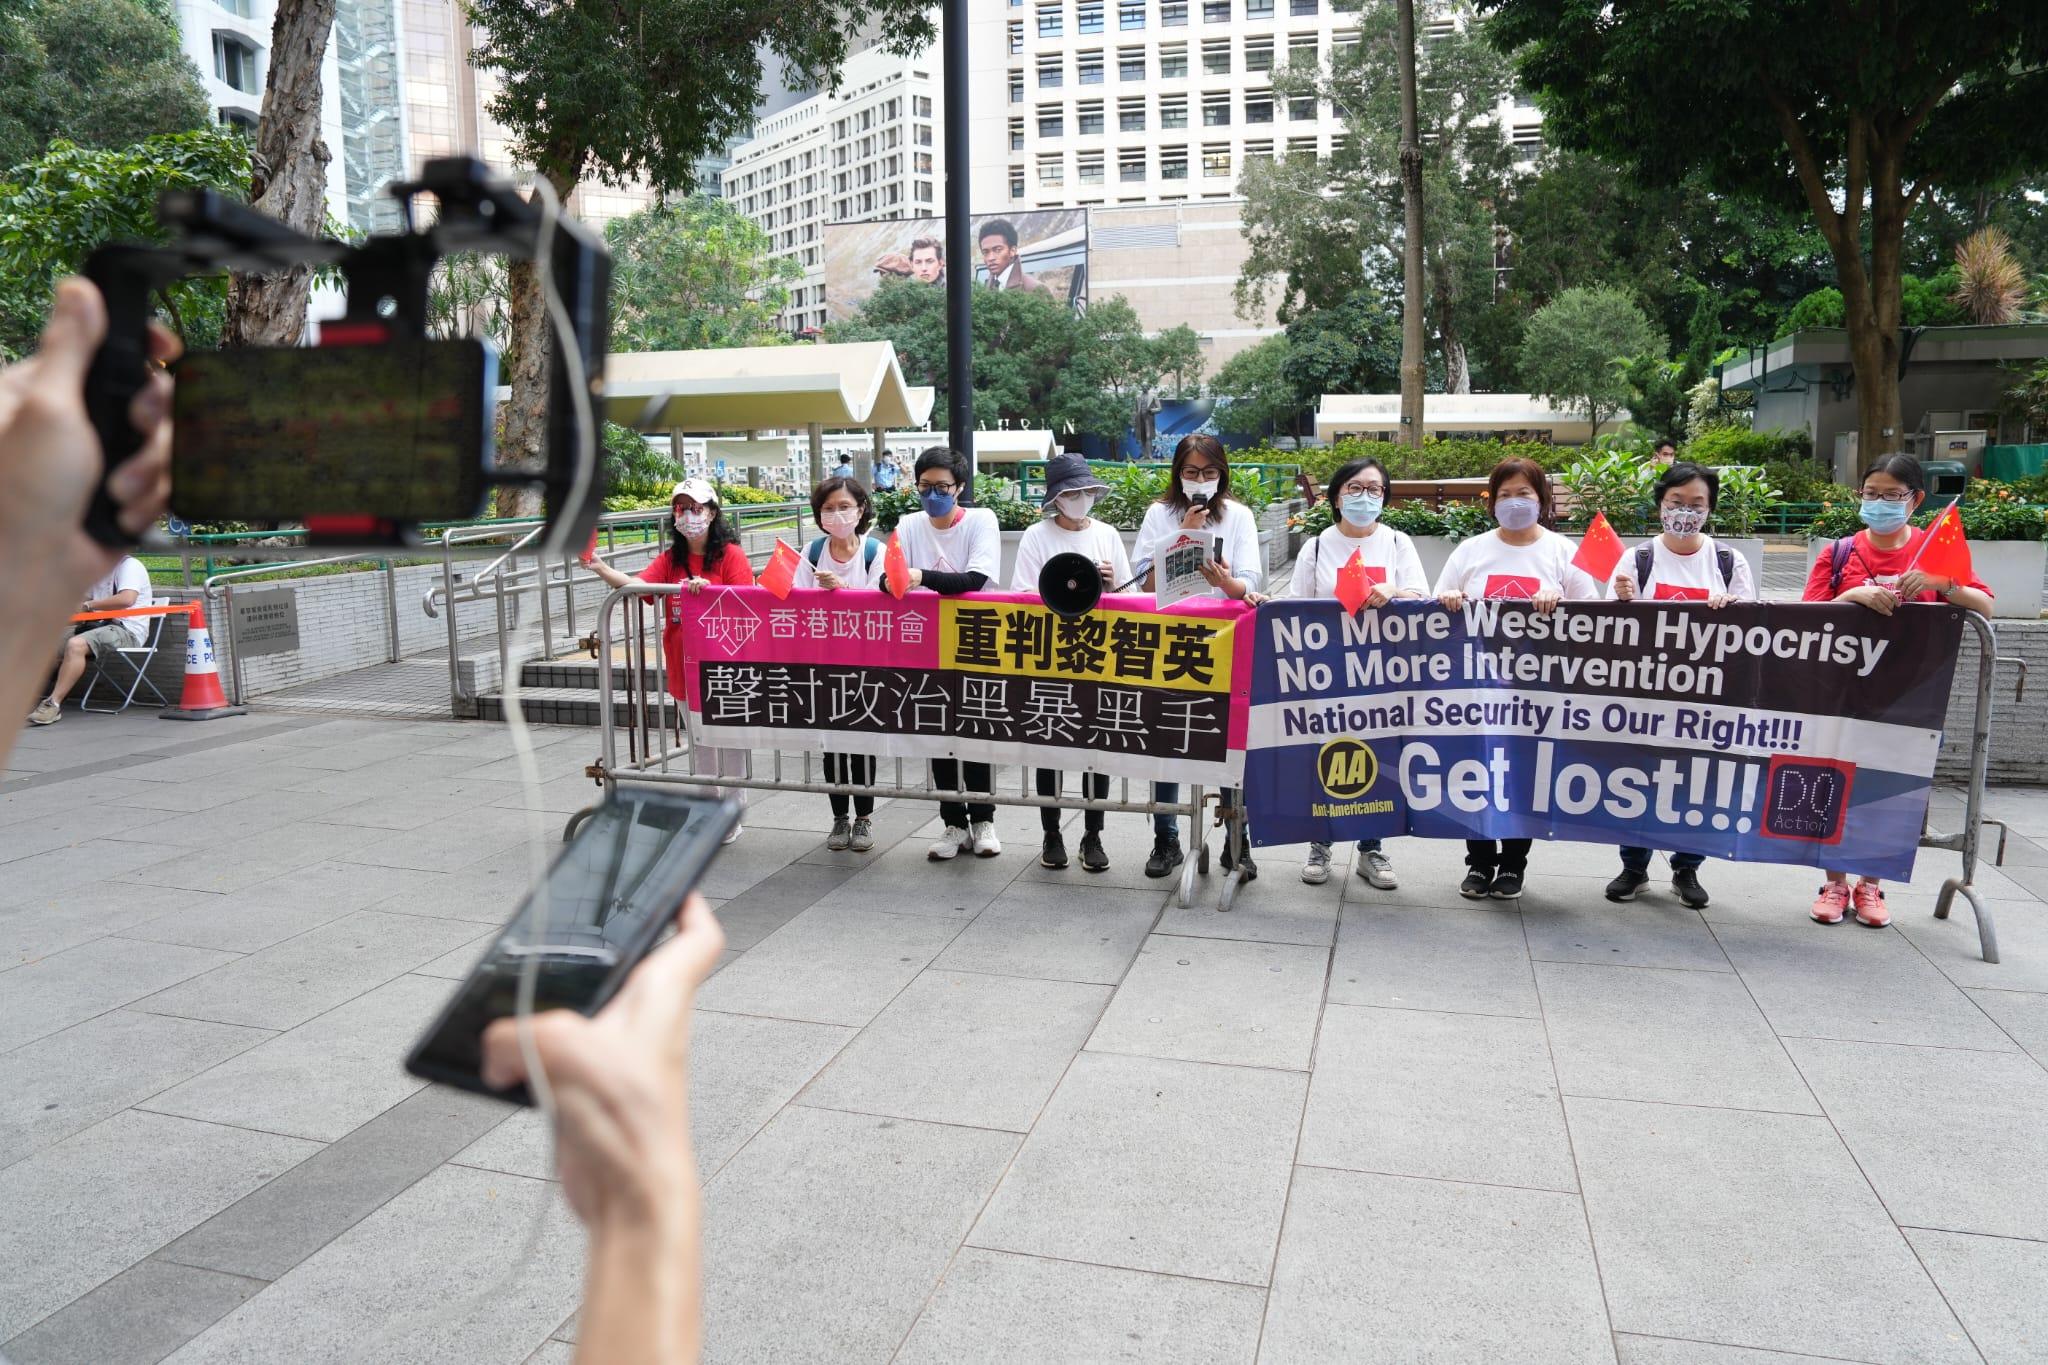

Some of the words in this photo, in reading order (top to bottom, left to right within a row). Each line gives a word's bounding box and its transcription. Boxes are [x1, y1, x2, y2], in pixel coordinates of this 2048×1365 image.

[768, 607, 928, 643] 香港政研會
[955, 608, 1217, 685] 重判黎智英
[1272, 615, 1328, 653] No
[1340, 608, 1450, 646] More
[1462, 601, 1640, 646] Western
[1654, 610, 1889, 677] Hypocrisy
[1277, 656, 1333, 693] No
[1344, 649, 1451, 688] More
[1463, 642, 1724, 696] Intervention
[706, 665, 1221, 754] 聲討政治黑暴黑手
[1283, 696, 1414, 736] National
[1424, 695, 1554, 735] Security
[1561, 699, 1591, 731] is
[1602, 703, 1664, 736] Our
[1674, 708, 1803, 750] Right!!!
[1326, 750, 1366, 787] AA
[1398, 741, 1510, 812] Get
[1532, 741, 1760, 834] lost!!!
[1774, 814, 1827, 833] Action
